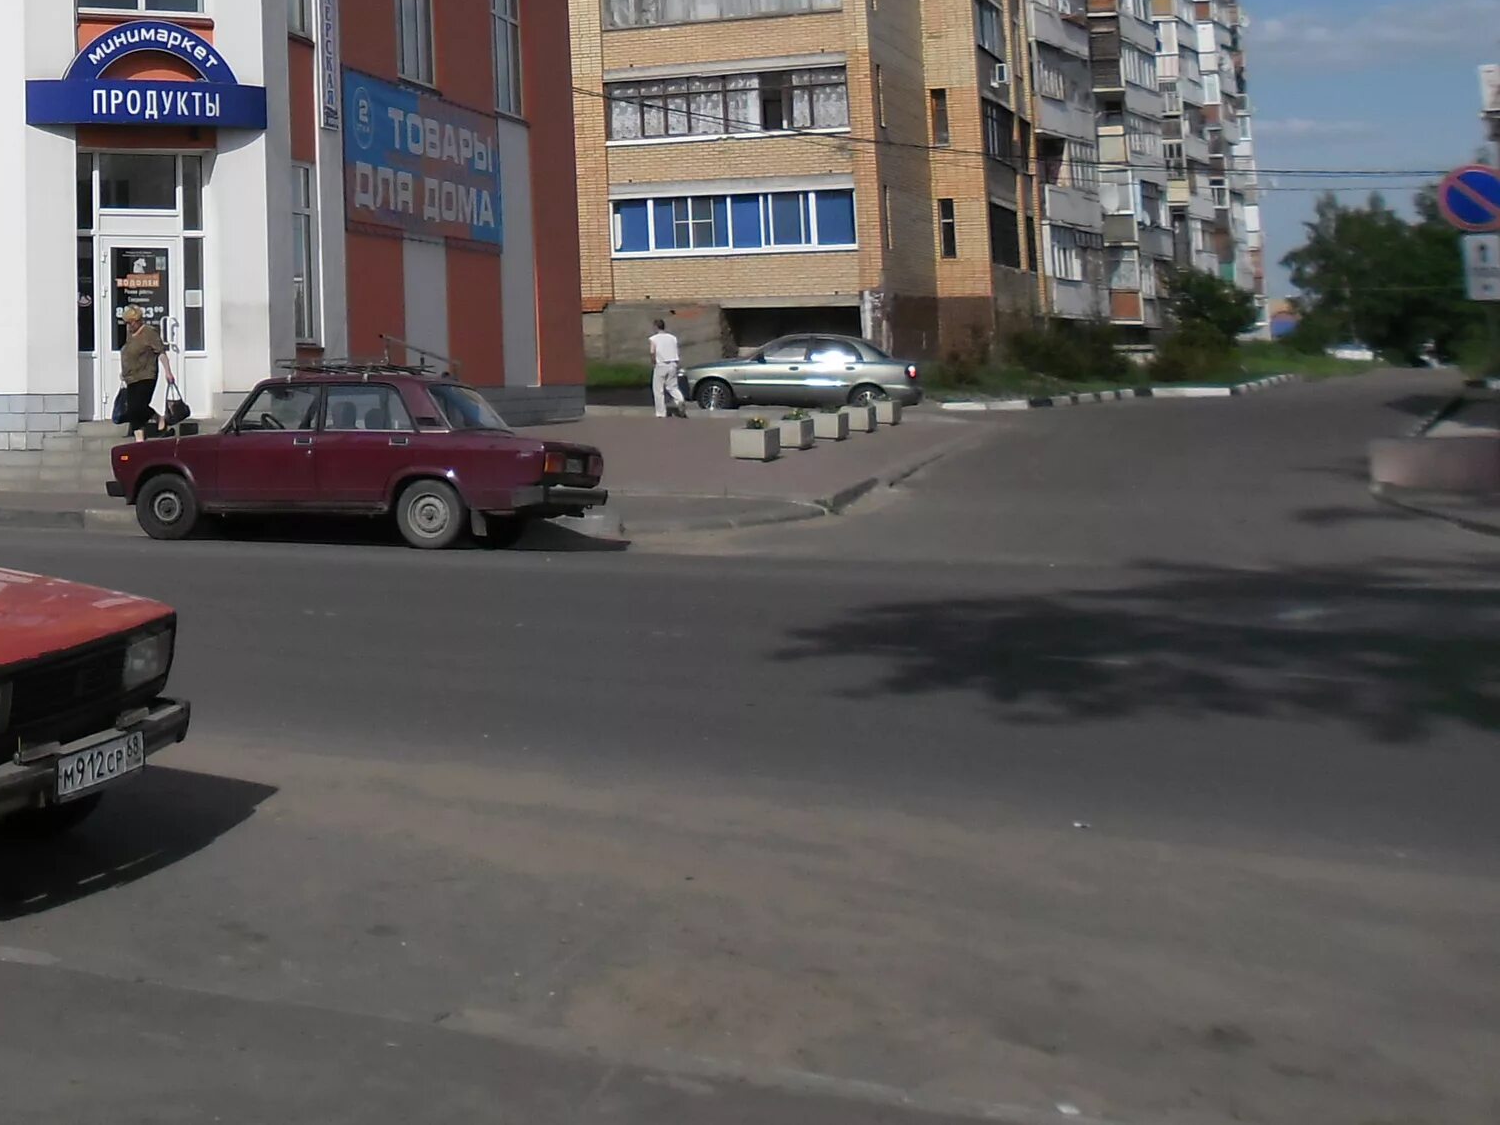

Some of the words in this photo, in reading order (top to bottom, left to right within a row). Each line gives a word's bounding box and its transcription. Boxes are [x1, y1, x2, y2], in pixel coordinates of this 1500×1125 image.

[92, 88, 221, 119] ПРОДУКТЫ
[358, 99, 369, 123] 2
[387, 106, 493, 173] ТОВАРЫ
[354, 161, 414, 214] ДЛЯ
[423, 177, 495, 228] ДОМА
